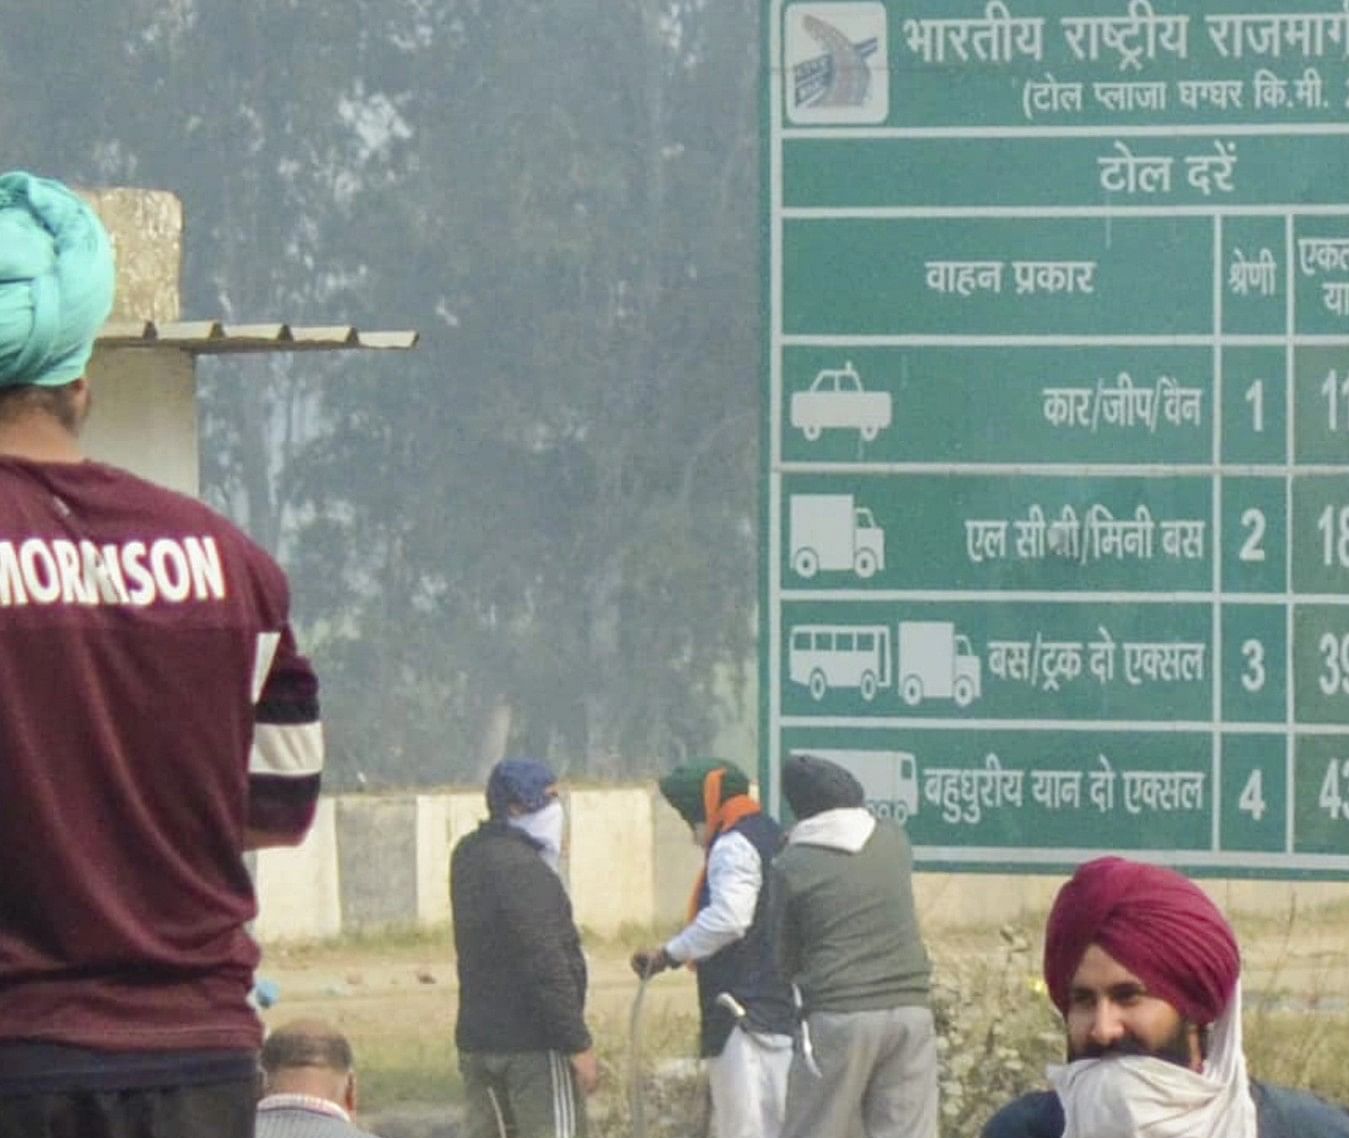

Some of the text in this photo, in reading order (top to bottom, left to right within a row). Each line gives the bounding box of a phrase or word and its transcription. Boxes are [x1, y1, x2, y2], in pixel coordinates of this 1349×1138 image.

[903, 0, 1045, 62] भारतीय
[1060, 0, 1190, 70] राष्ट्रीय
[1022, 73, 1083, 119] (टोल
[1093, 82, 1167, 110] प्लाजा
[1097, 140, 1237, 195] टोल दरें
[925, 261, 1097, 296] वाहन प्रकार
[1228, 247, 1276, 295] श्रेणी
[1245, 379, 1263, 432] 1
[965, 520, 1008, 562] एल
[1160, 520, 1205, 558] बस
[1239, 507, 1266, 560] 2
[987, 625, 1206, 691] बस/ट्रक दो एक्सल
[1242, 639, 1265, 692] 3
[1031, 769, 1079, 811] यान
[1089, 753, 1116, 813] दो
[1123, 769, 1204, 814] एक्सल
[1239, 769, 1265, 820] 4
